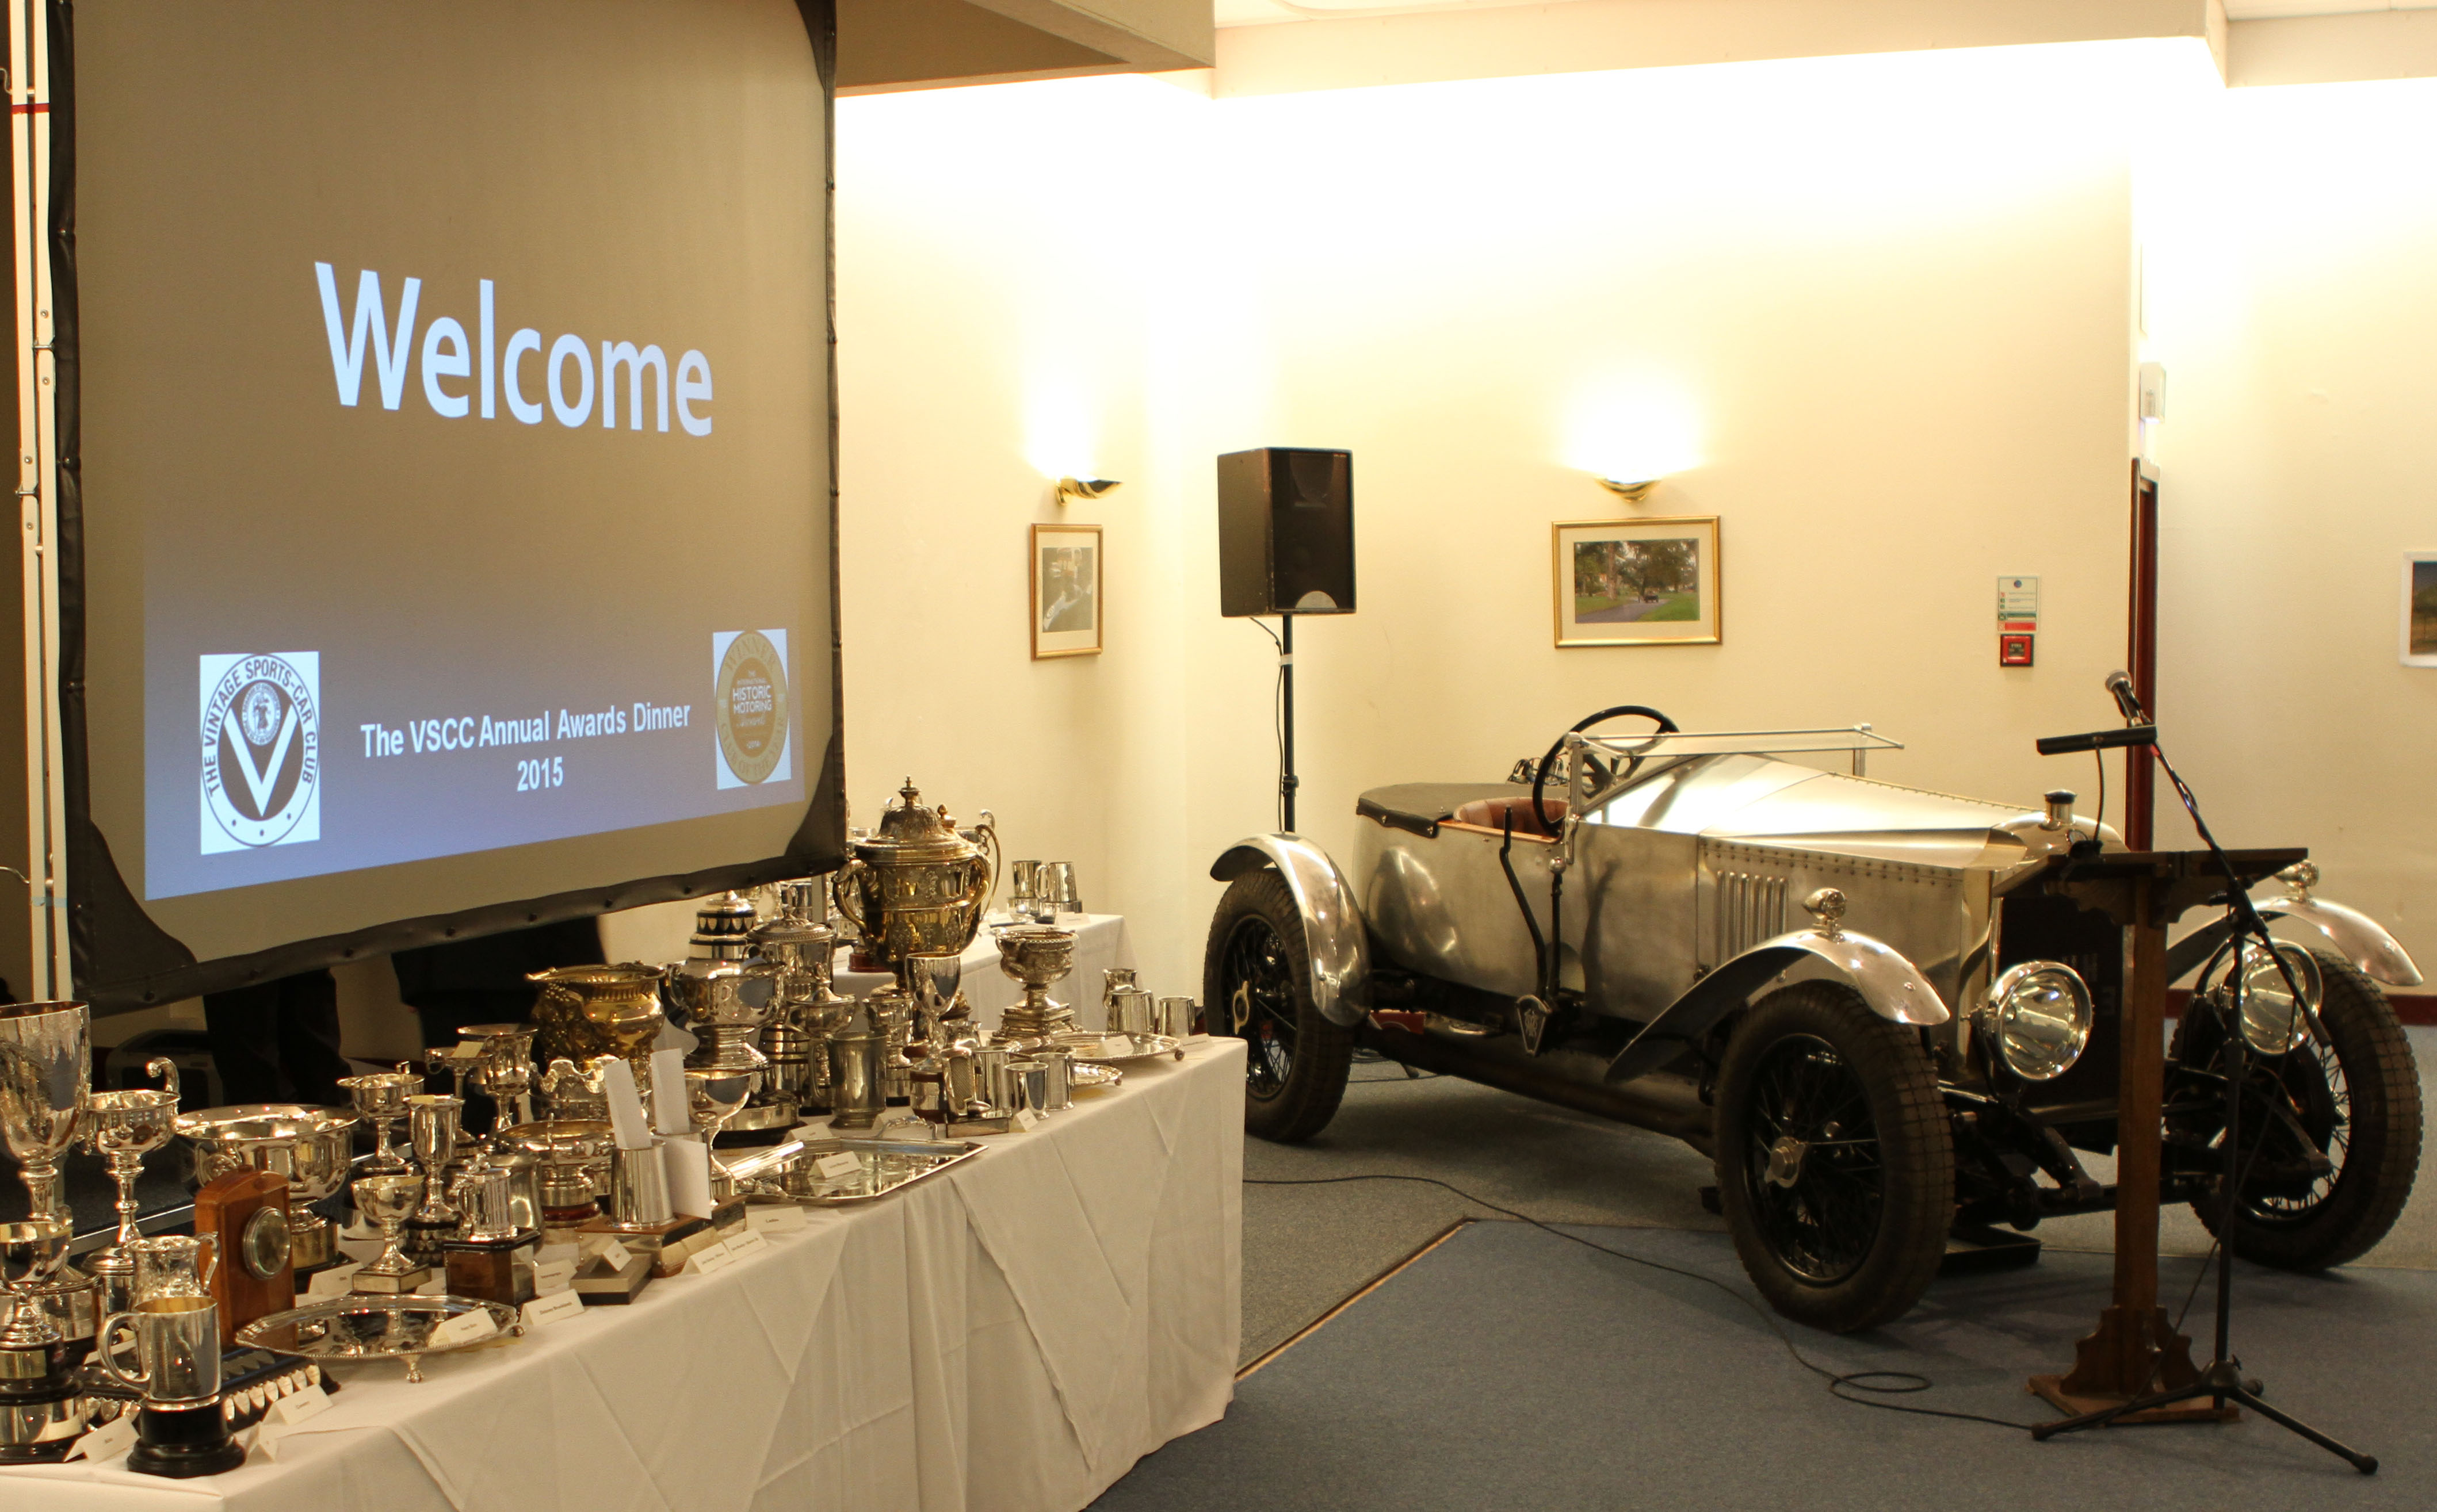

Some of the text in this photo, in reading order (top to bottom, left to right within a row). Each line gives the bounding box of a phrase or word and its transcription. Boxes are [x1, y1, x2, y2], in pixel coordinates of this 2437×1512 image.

[315, 261, 713, 437] Welcome
[204, 669, 242, 747] VINTAGE
[245, 659, 312, 725] SPORTS-CAR
[732, 685, 771, 701] HISTORIC
[733, 699, 772, 714] MOTORING
[303, 730, 316, 784] CLUB
[360, 702, 690, 758] The VSCC Annual Awards Dinner
[204, 755, 220, 797] THE
[517, 756, 563, 792] 2015
